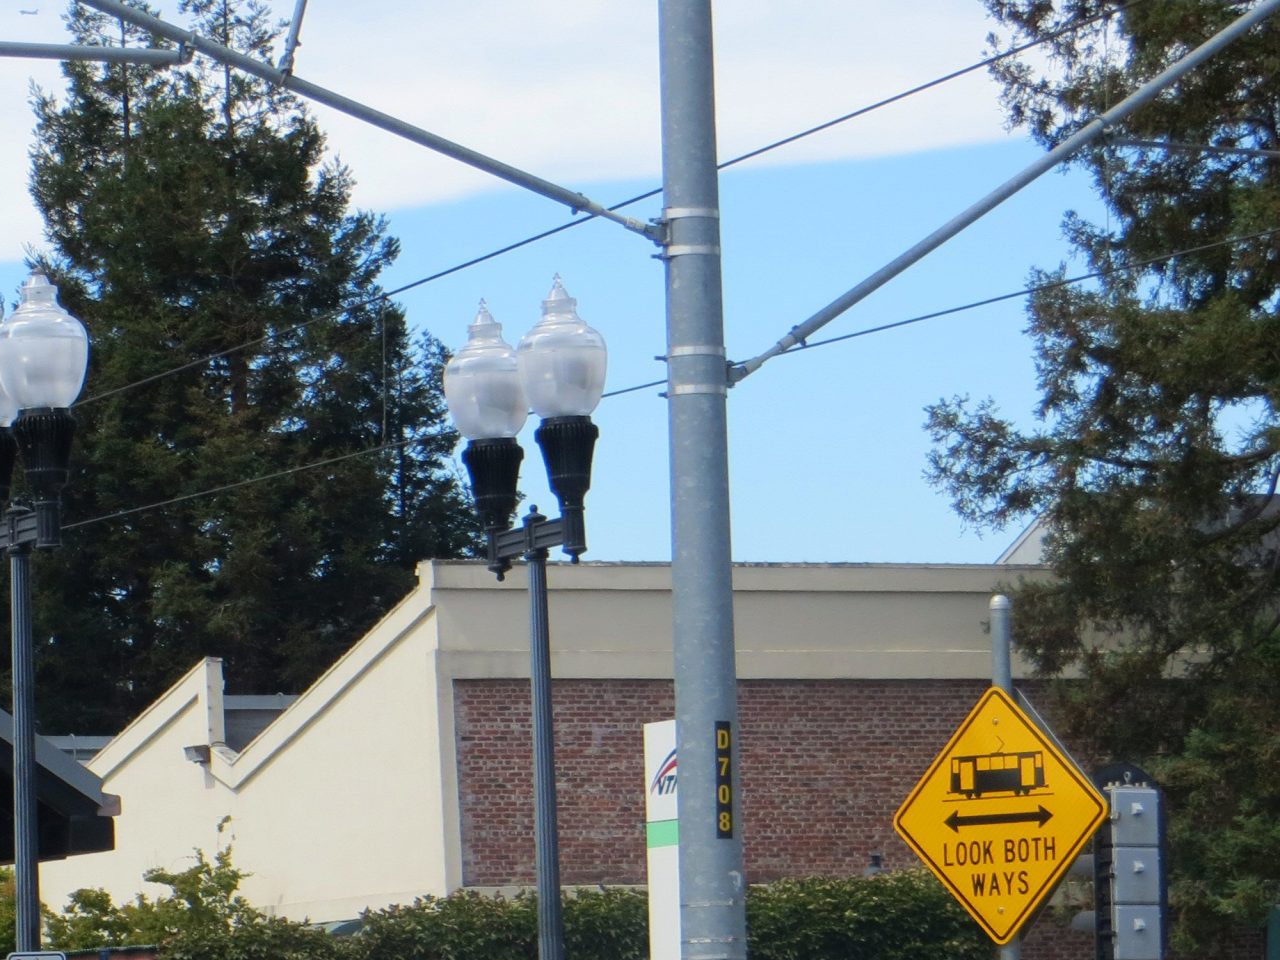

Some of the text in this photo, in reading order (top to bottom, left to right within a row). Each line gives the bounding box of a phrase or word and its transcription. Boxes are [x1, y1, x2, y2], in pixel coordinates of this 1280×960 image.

[717, 729, 731, 832] D708
[943, 836, 1056, 867] LOOK BOTH
[971, 871, 1030, 897] WAYS
